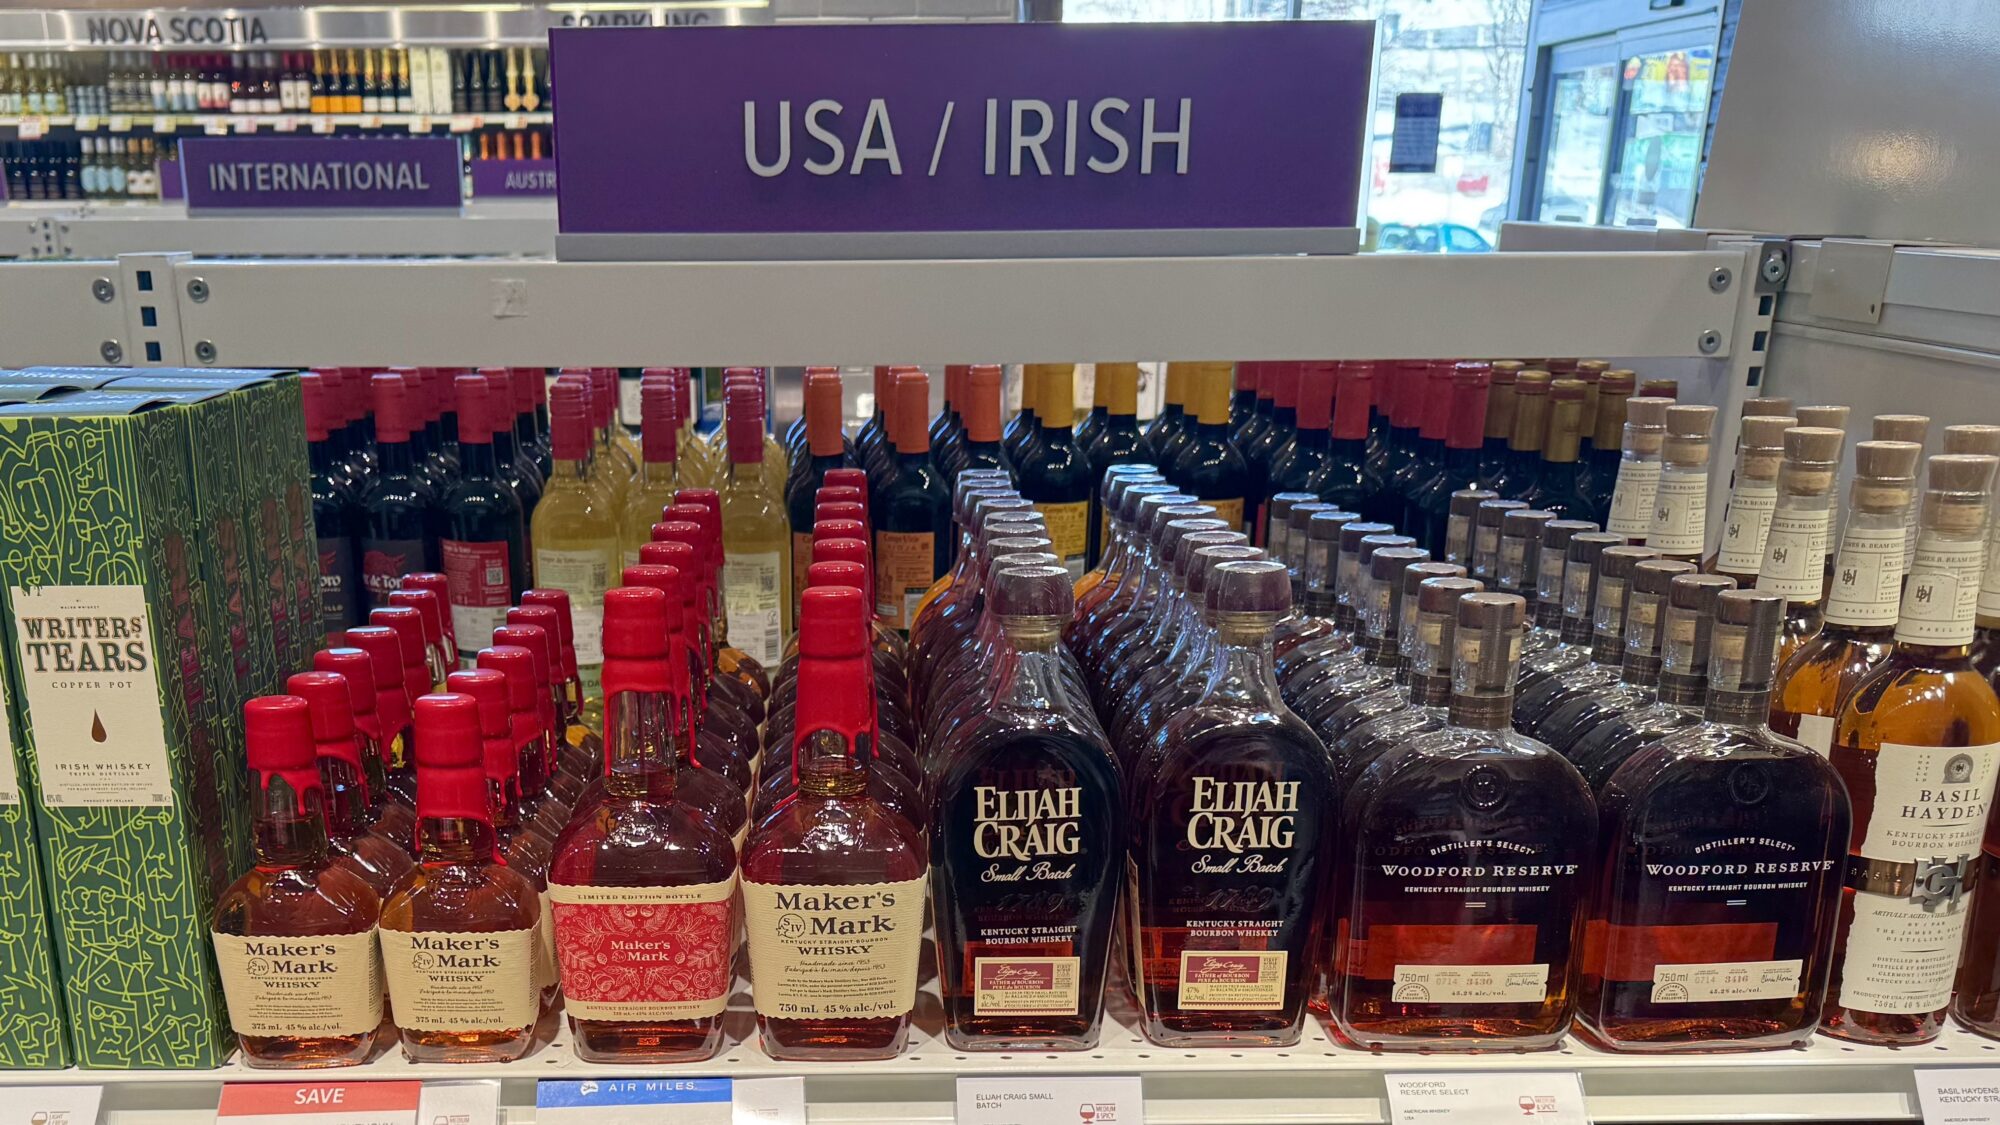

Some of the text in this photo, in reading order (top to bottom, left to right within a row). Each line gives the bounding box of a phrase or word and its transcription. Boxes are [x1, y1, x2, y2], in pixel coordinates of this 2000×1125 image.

[88, 18, 268, 45] NOVA SCOTIA
[744, 97, 1192, 177] USA / IRISH
[209, 161, 430, 191] INTERNATIONAL
[1946, 555, 1968, 563] BEAM
[26, 642, 148, 672] TEARS
[51, 681, 101, 689] COPPER
[1189, 776, 1301, 818] ELIJAH
[1919, 788, 1981, 803] BASIL
[973, 786, 1082, 827] ELIJAH
[1900, 804, 1986, 820] HAYDEN
[1187, 812, 1295, 853] CRAIG
[1886, 830, 1946, 840] KENTUCKY
[973, 821, 1081, 861] CRAIG
[1695, 837, 1794, 854] DISTILLER'S SELECT
[1891, 839, 1945, 849] BOURBON
[1430, 840, 1533, 856] DISTILLER'S SELECT
[1191, 854, 1289, 874] Small Batch
[1382, 864, 1577, 877] WOODFORD RESERVE
[1646, 860, 1833, 876] WOODFORD RESERVE
[981, 861, 1077, 883] Small Batch
[775, 892, 896, 911] Maker's
[1872, 910, 1909, 918] ARTFULLY
[810, 914, 895, 936] Mark
[1031, 926, 1078, 934] STRAIGHT
[1187, 920, 1285, 928] KENTUCKY STRAIGHT
[1190, 929, 1279, 937] BOURBON WHISKEY
[410, 937, 499, 950] Maker's
[611, 940, 671, 950] Maker's
[985, 935, 1074, 945] BOURBON WHISKEY
[245, 942, 336, 956] Maker's
[797, 944, 873, 956] WHISKY
[437, 954, 501, 967] Mark
[628, 951, 670, 962] Mark
[272, 960, 336, 974] Mark
[1400, 973, 1430, 982] 750ml
[1659, 972, 1689, 982] 750ml
[1853, 990, 1881, 999] PRODUCT
[779, 1001, 896, 1013] 750 mL 45 % alc./vol.
[297, 1022, 306, 1030] %
[608, 1081, 694, 1092] AIR MILES
[294, 1087, 345, 1105] SAVE
